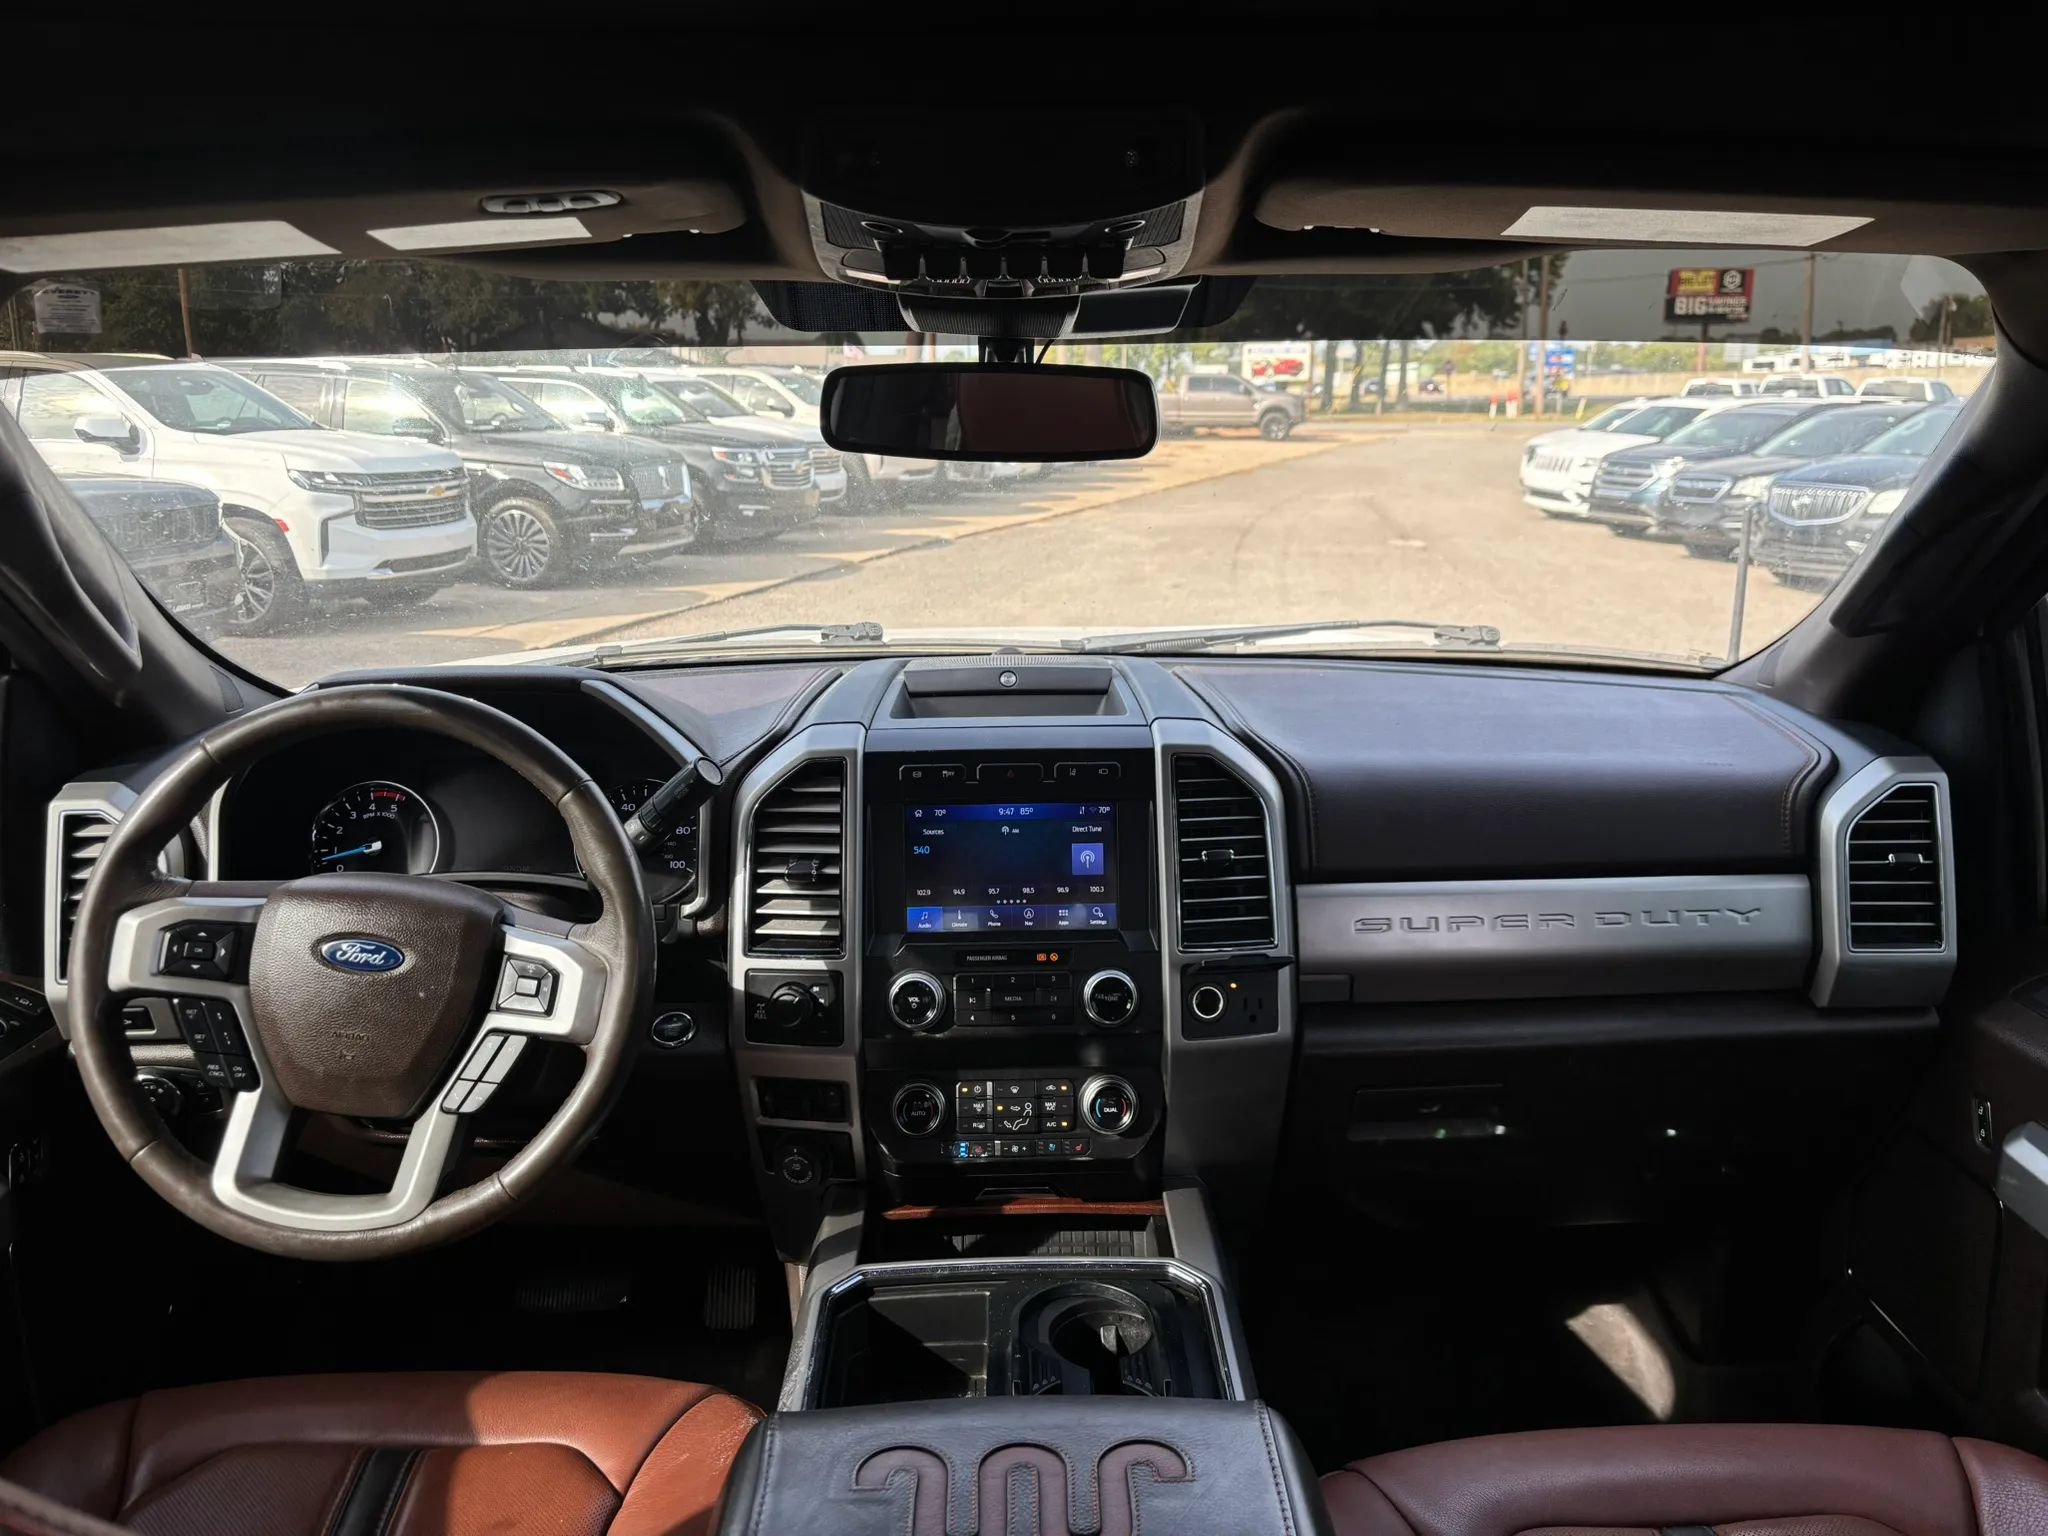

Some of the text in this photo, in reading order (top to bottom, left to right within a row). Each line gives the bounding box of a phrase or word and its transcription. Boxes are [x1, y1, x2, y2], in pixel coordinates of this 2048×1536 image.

[1674, 296, 1707, 315] BIG
[621, 803, 635, 811] 40
[999, 807, 1015, 816] 9:47
[350, 811, 357, 819] 3
[336, 826, 343, 834] 2
[676, 826, 691, 835] 80
[1072, 825, 1102, 833] Direct Tune
[913, 846, 930, 854] 540
[670, 860, 686, 869] 100
[1353, 907, 1761, 934] SUPER DUTY
[336, 942, 387, 965] Ford
